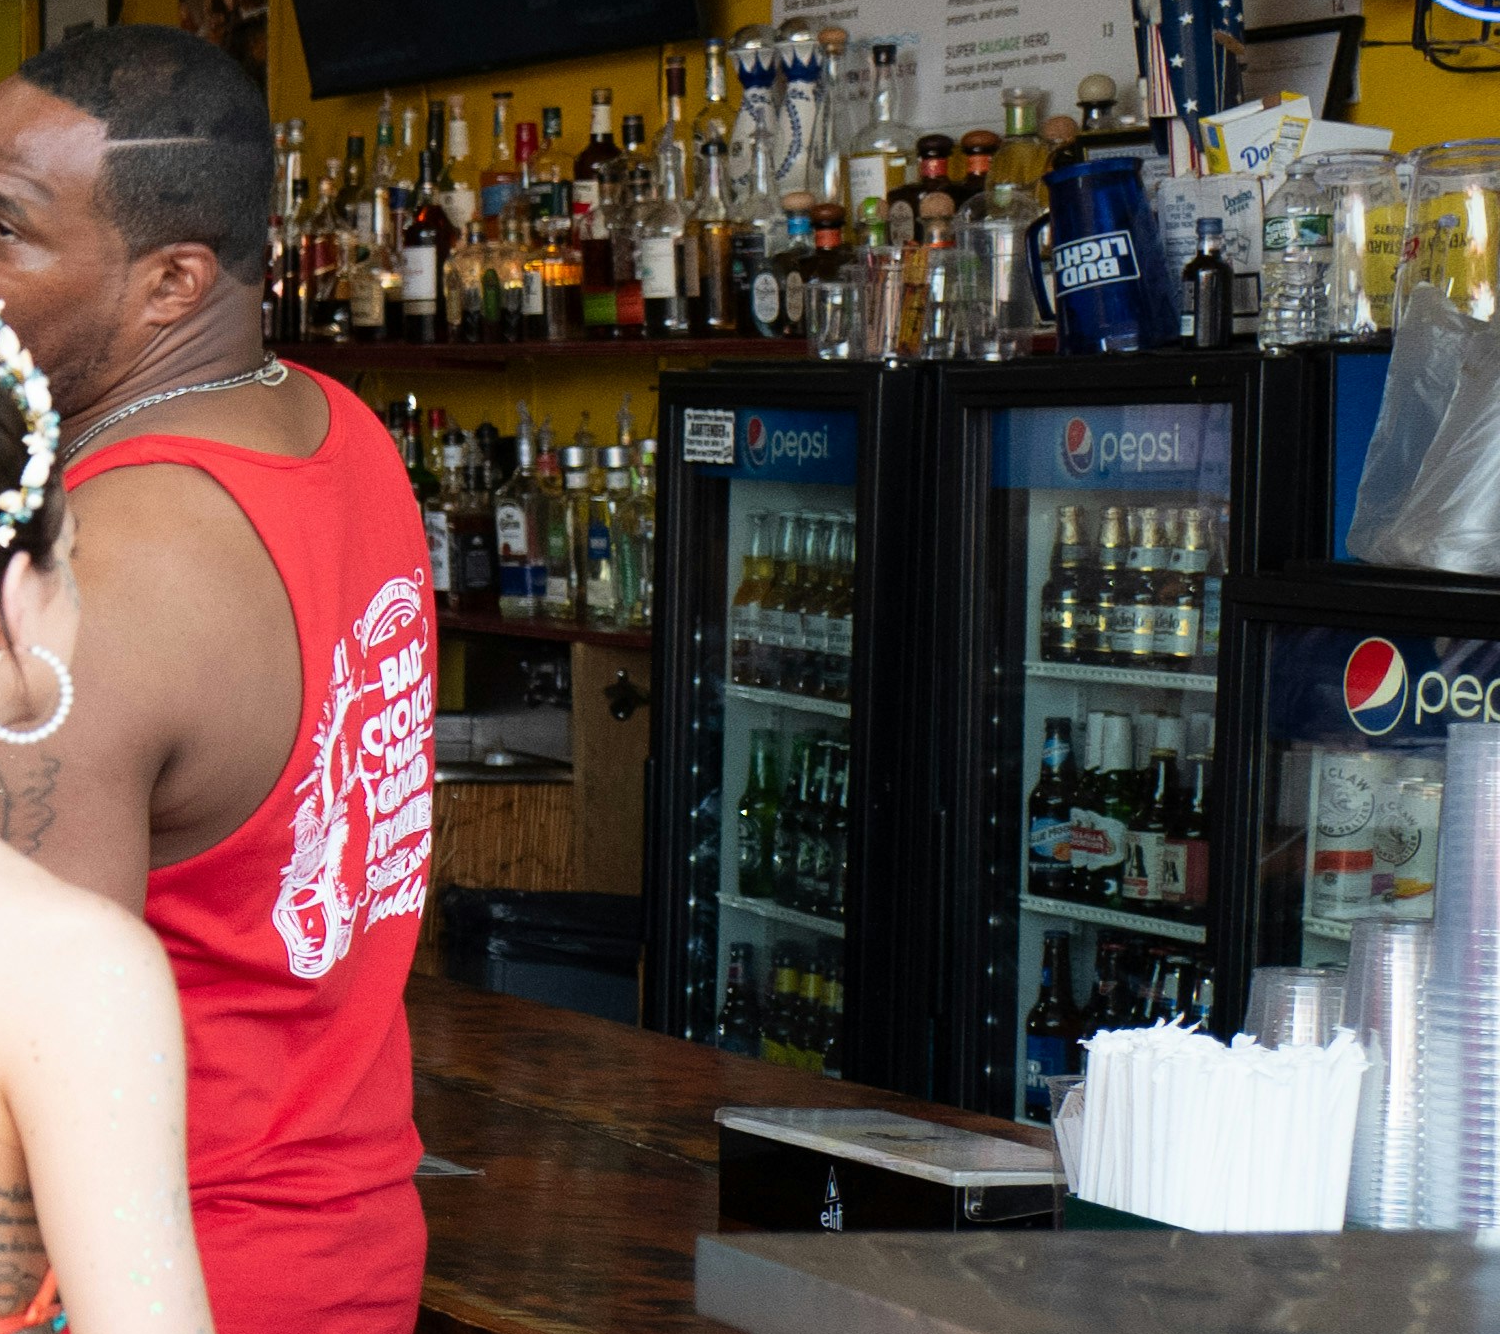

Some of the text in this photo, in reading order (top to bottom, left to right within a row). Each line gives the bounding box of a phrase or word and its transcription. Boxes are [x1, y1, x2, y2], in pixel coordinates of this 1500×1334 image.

[1057, 235, 1129, 269] LIGHT
[1061, 256, 1121, 290] BUD
[770, 425, 829, 465] pepsi
[1101, 423, 1180, 464] pepsi
[379, 638, 423, 700] BAD
[377, 754, 428, 815] GOOD
